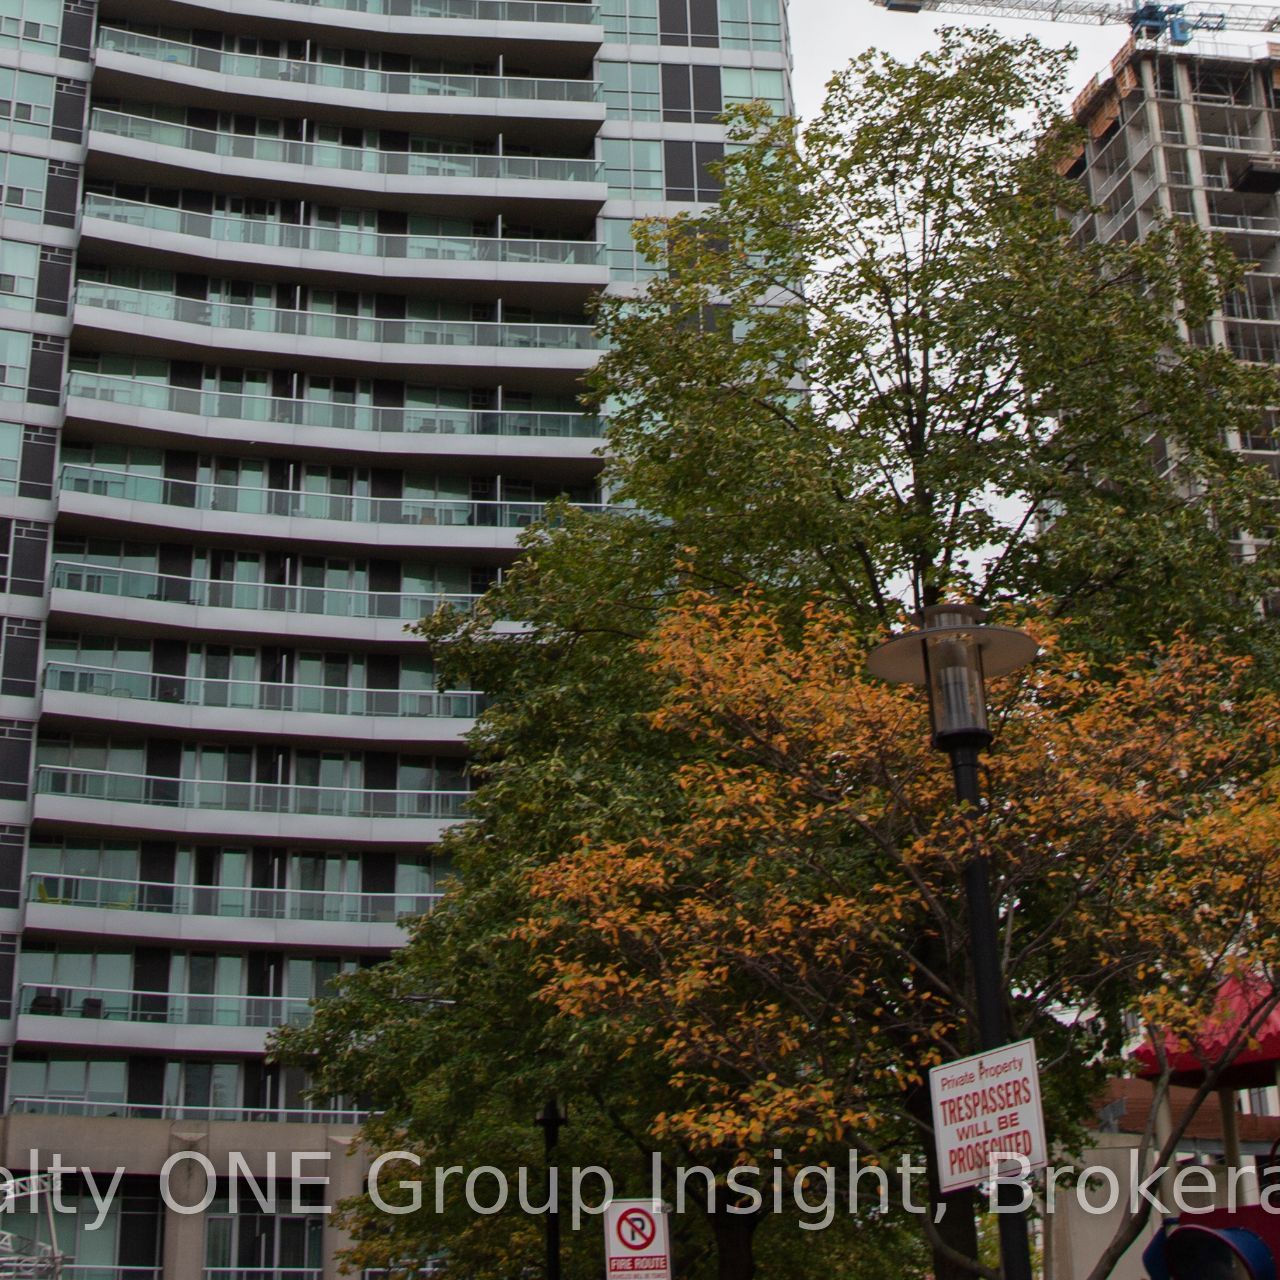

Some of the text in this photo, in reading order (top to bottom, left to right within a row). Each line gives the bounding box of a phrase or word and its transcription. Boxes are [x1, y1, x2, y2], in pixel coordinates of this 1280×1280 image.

[941, 1057, 1024, 1092] Private Property
[939, 1077, 1032, 1126] TRESPASSERS
[956, 1112, 1020, 1141] WILL BE
[949, 1130, 1033, 1176] PROSECUTED
[611, 1257, 666, 1270] FIRE ROUTE
